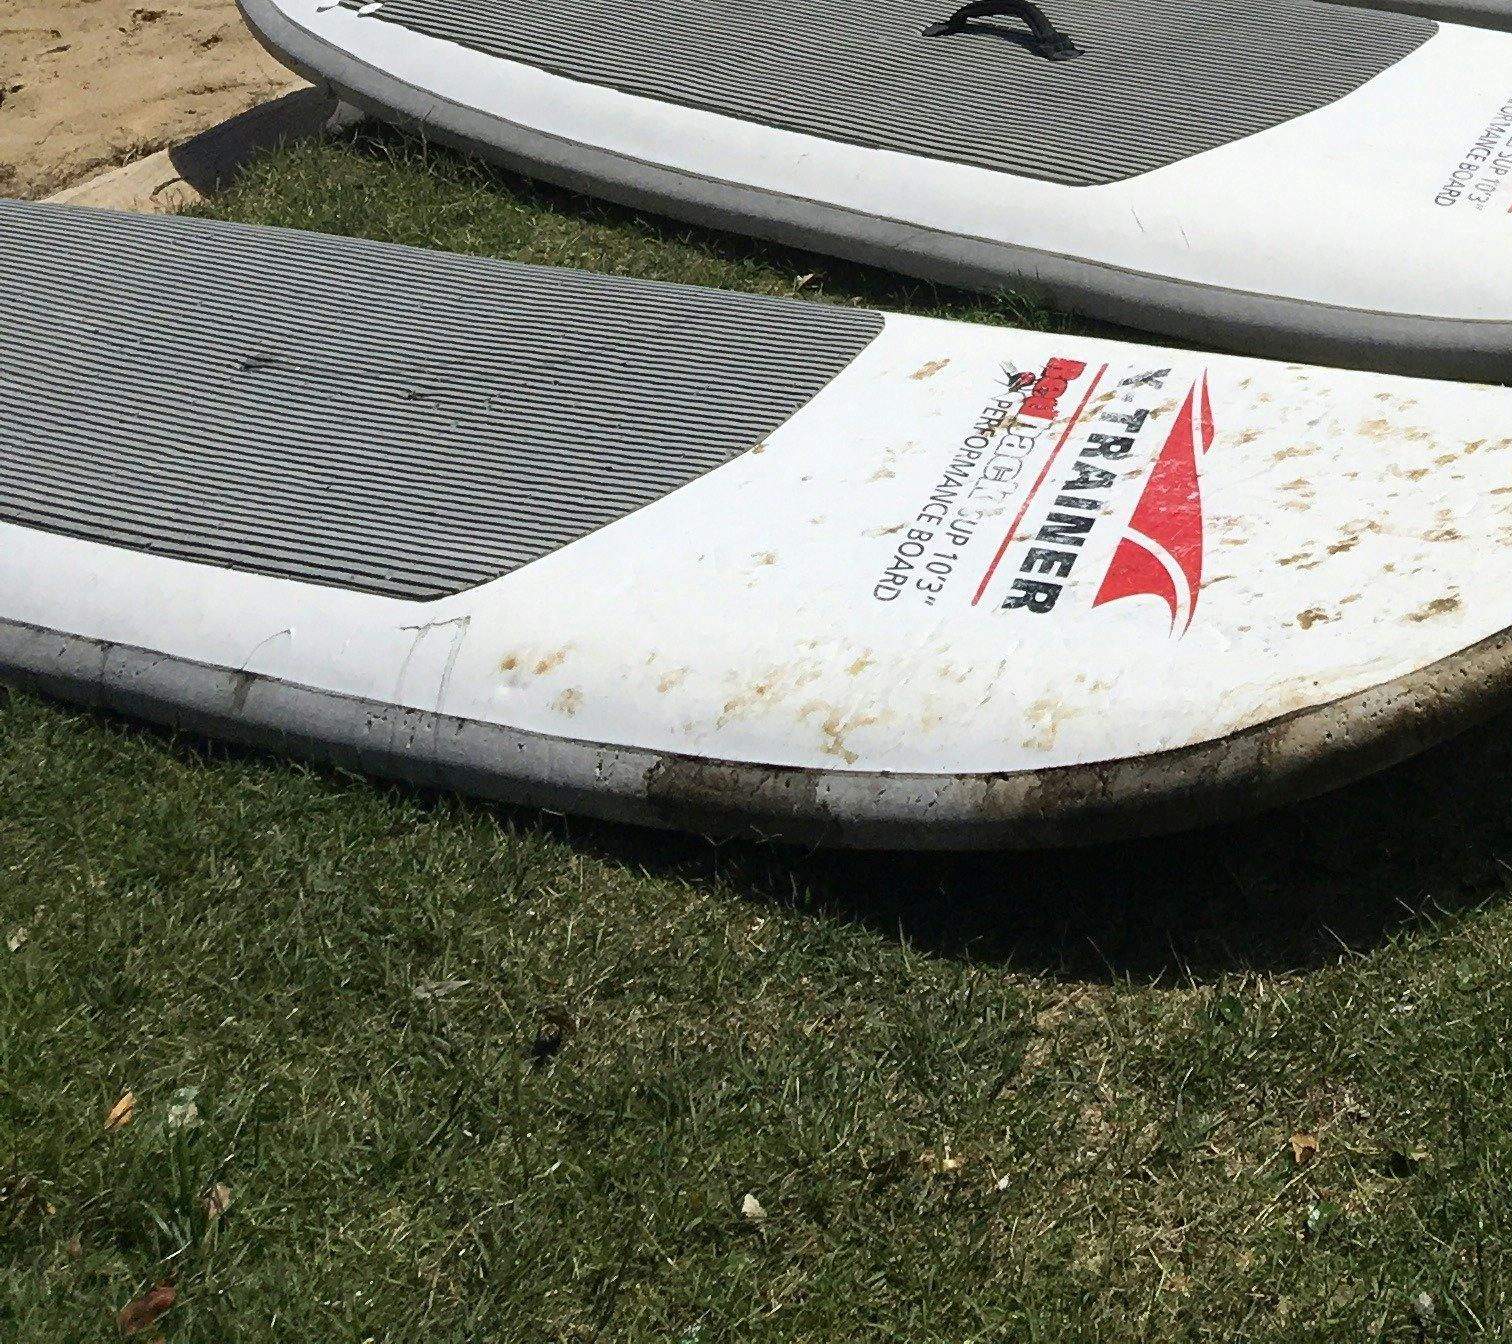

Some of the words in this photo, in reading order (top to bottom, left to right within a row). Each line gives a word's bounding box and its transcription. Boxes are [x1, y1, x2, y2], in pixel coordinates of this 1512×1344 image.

[1431, 161, 1481, 206] BOARD
[913, 398, 1014, 523] PERFORMANCE
[944, 507, 977, 545] SUP
[868, 528, 935, 601] BOARD
